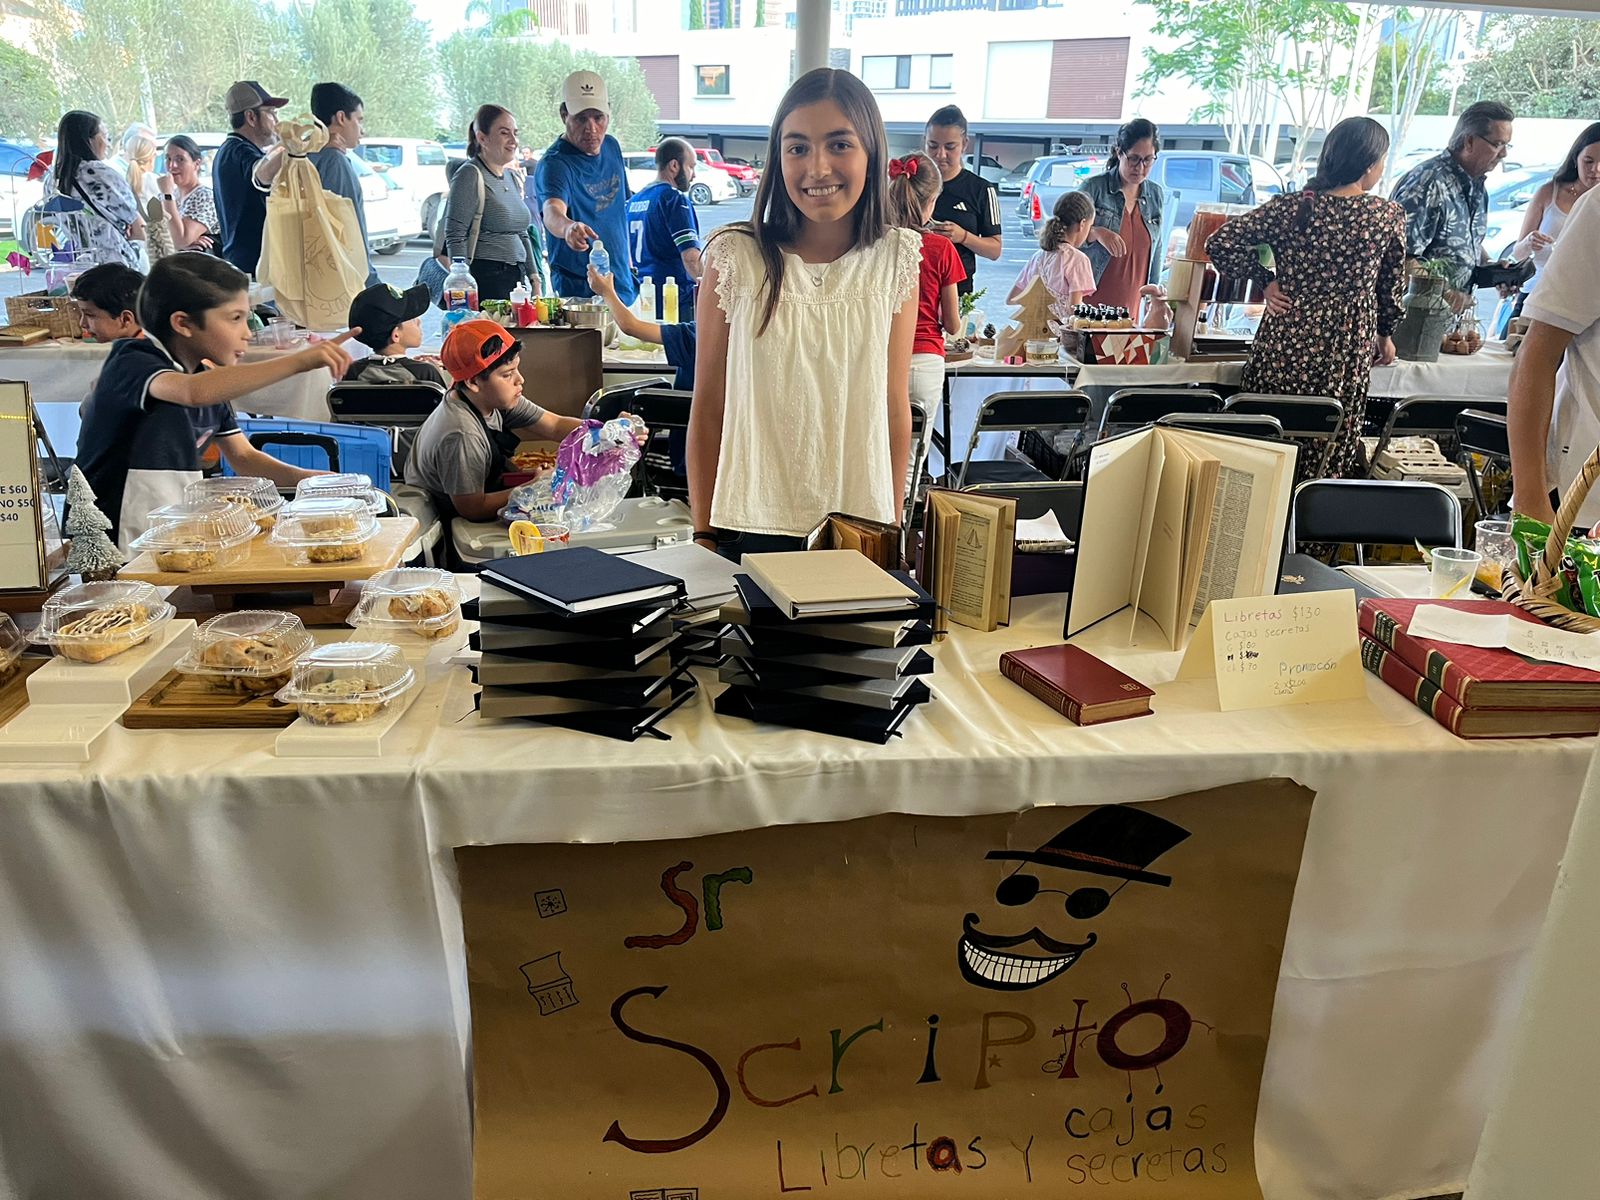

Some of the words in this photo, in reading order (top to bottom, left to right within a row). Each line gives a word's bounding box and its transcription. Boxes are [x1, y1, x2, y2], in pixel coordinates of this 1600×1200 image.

[630, 220, 643, 263] 7
[9, 485, 28, 494] $60
[0, 513, 19, 522] $40
[1224, 608, 1283, 623] Libretas
[1293, 606, 1321, 622] $130
[1265, 625, 1311, 639] secretas
[1065, 1104, 1208, 1147] cajas
[776, 1122, 988, 1193] Libretas
[1066, 1142, 1228, 1186] secretas
